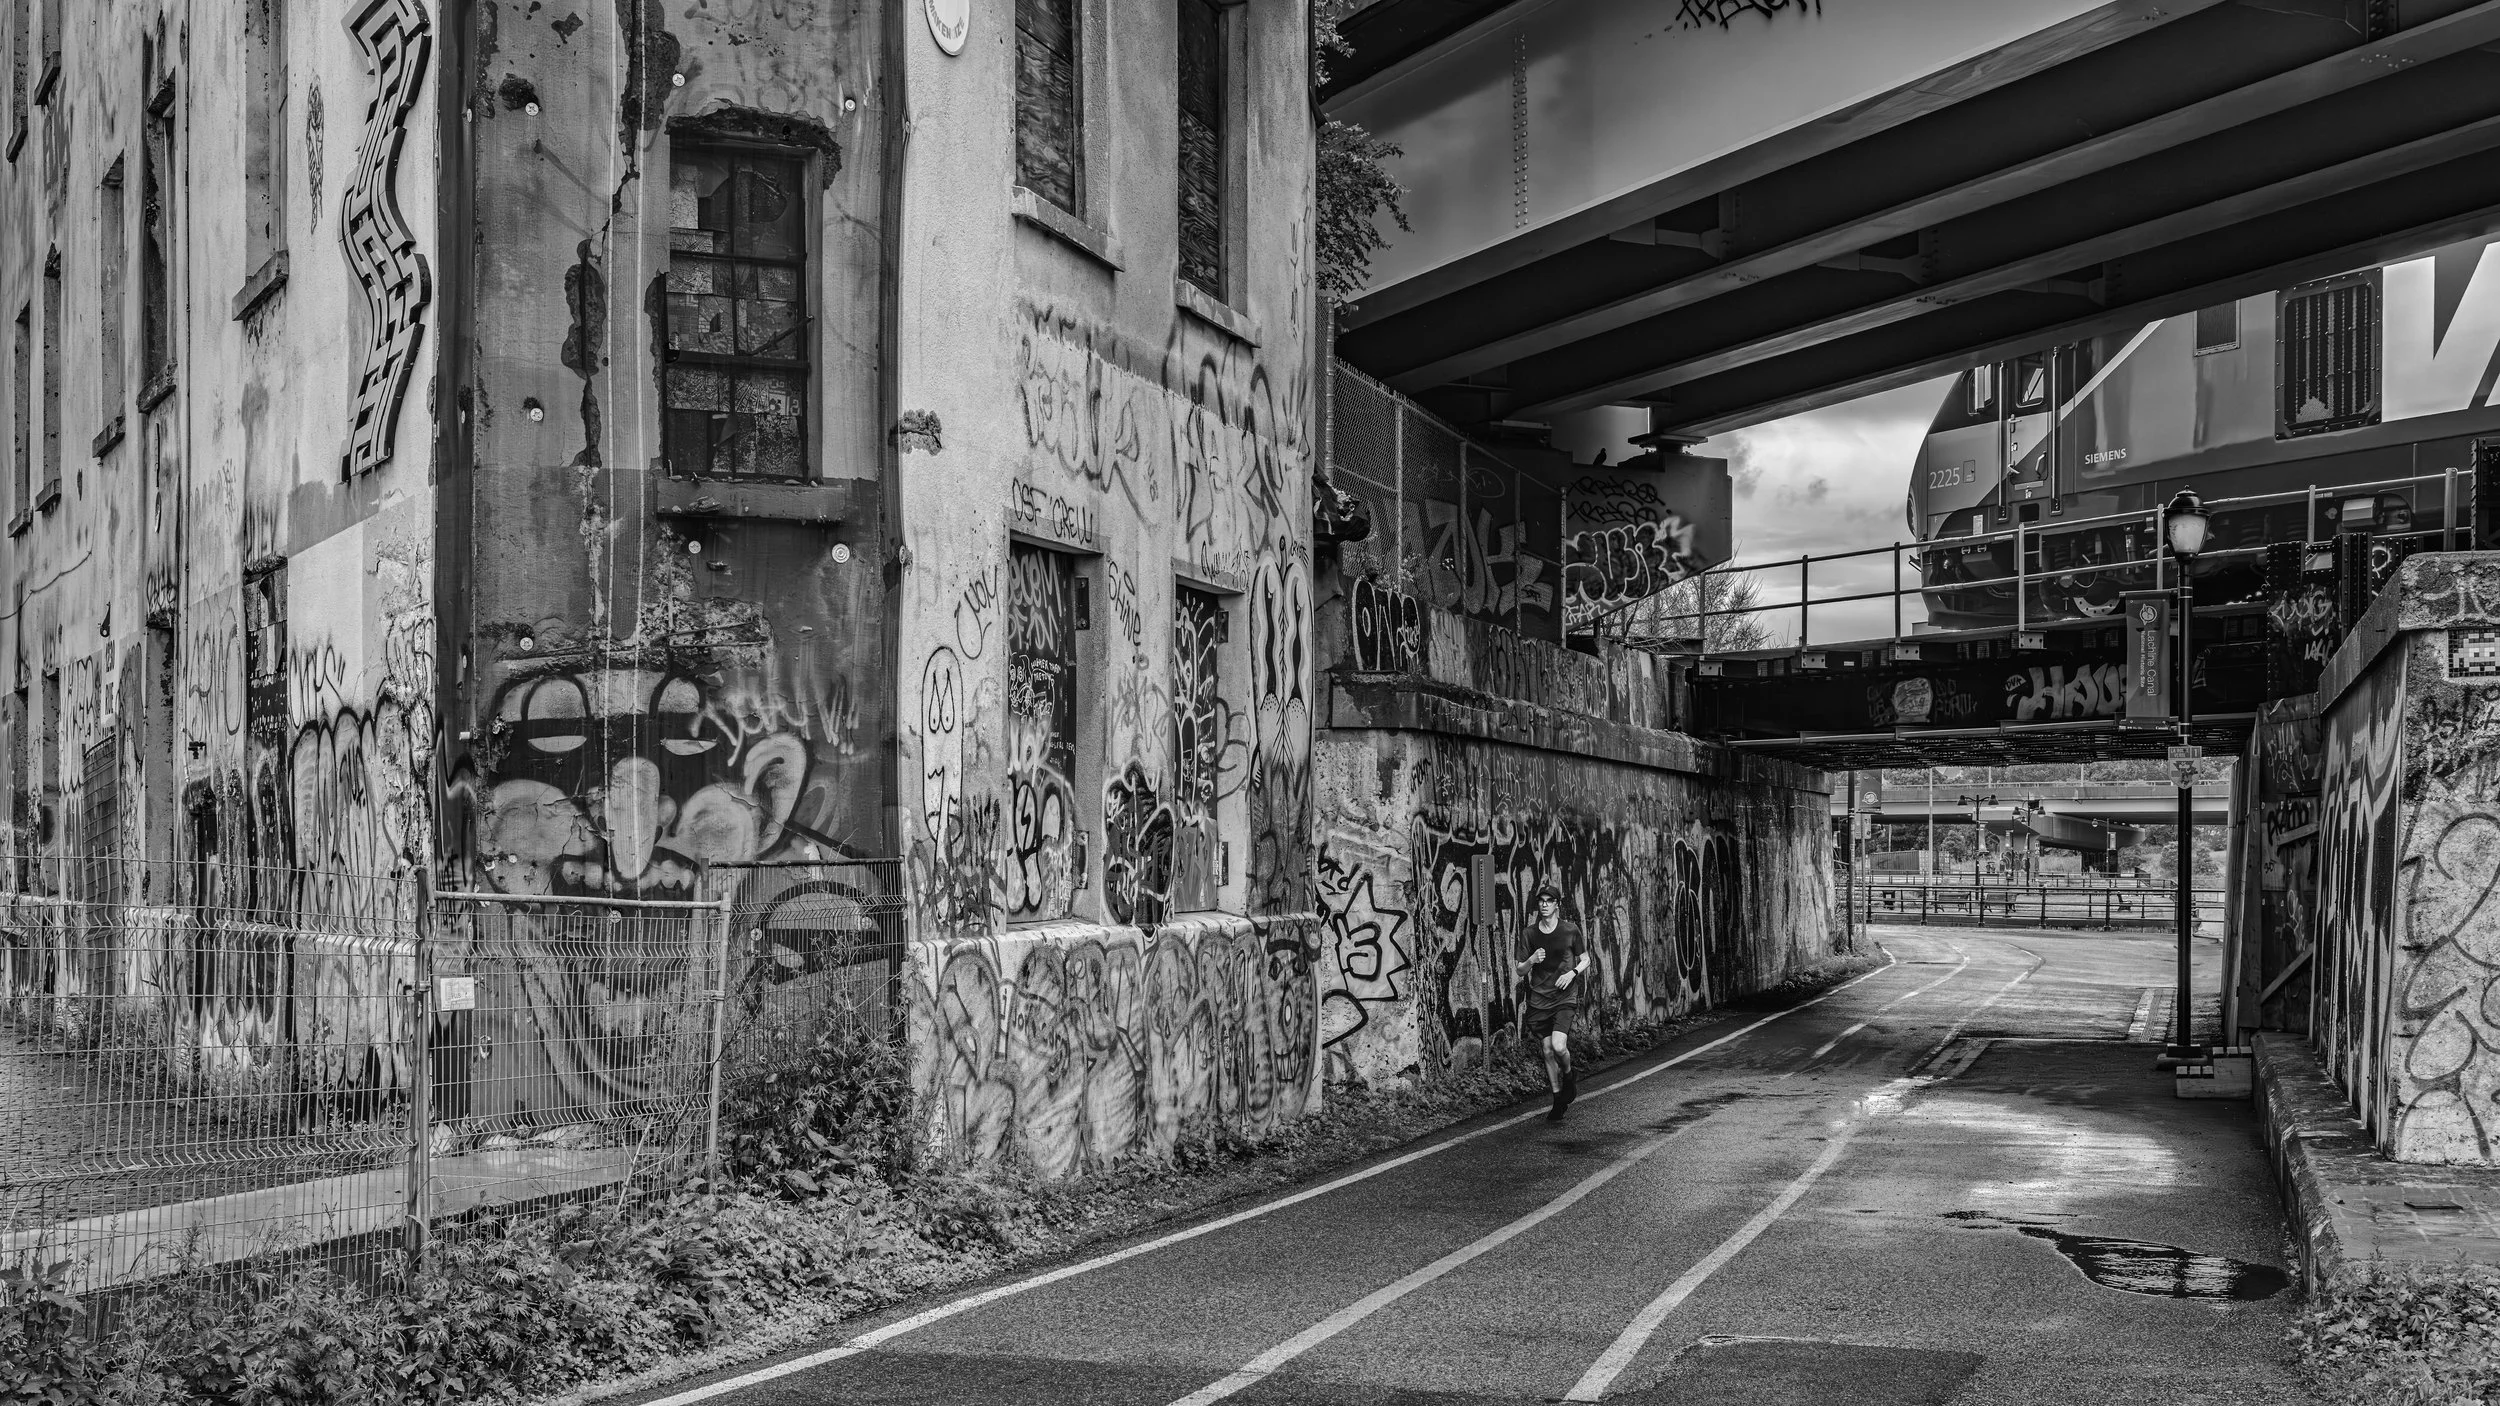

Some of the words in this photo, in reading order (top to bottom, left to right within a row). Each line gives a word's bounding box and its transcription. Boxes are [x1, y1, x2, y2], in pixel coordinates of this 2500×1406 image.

[2084, 448, 2127, 465] SIEMENS
[1929, 467, 1960, 489] 2225
[2147, 630, 2157, 667] Lachine
[2147, 669, 2157, 696] Canal
